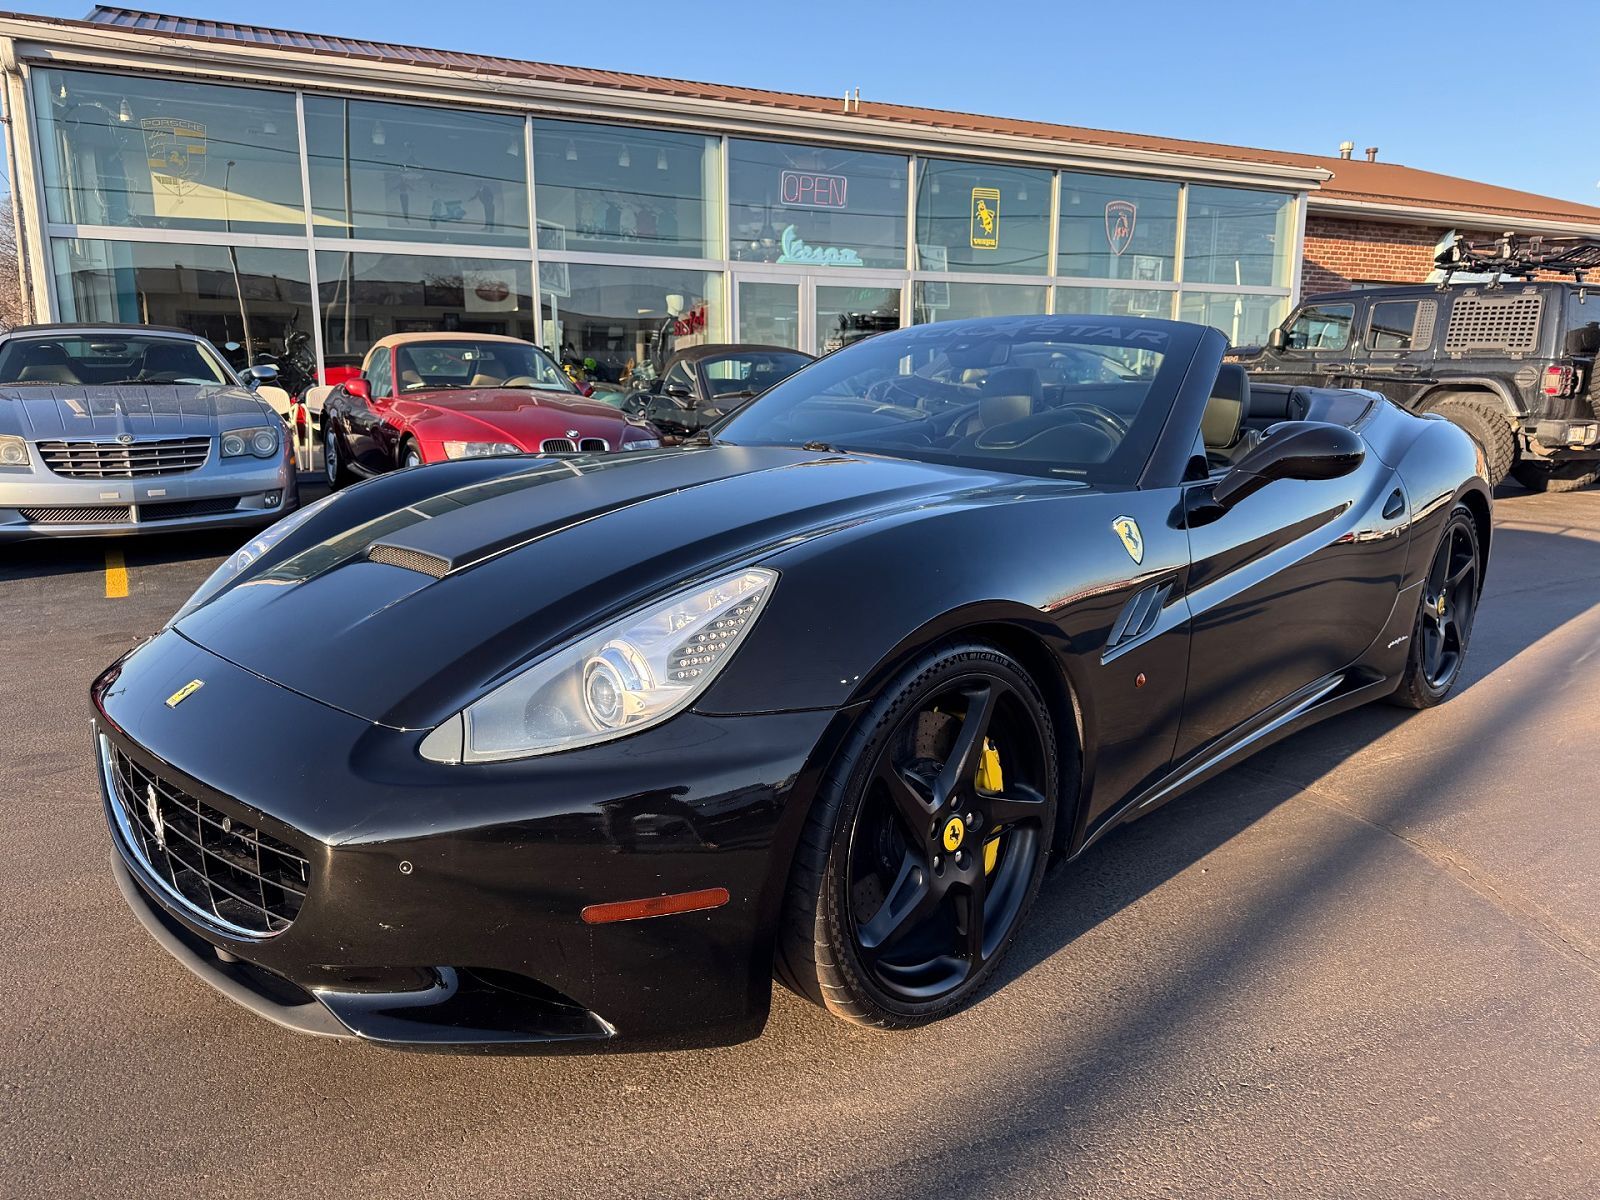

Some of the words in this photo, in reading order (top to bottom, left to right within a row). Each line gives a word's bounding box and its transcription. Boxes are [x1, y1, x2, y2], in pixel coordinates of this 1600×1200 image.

[143, 119, 202, 131] PORSCHE
[784, 175, 844, 205] OPEN
[778, 224, 863, 266] Vespa
[1030, 325, 1168, 343] STAR
[969, 653, 1009, 665] MICHELIN
